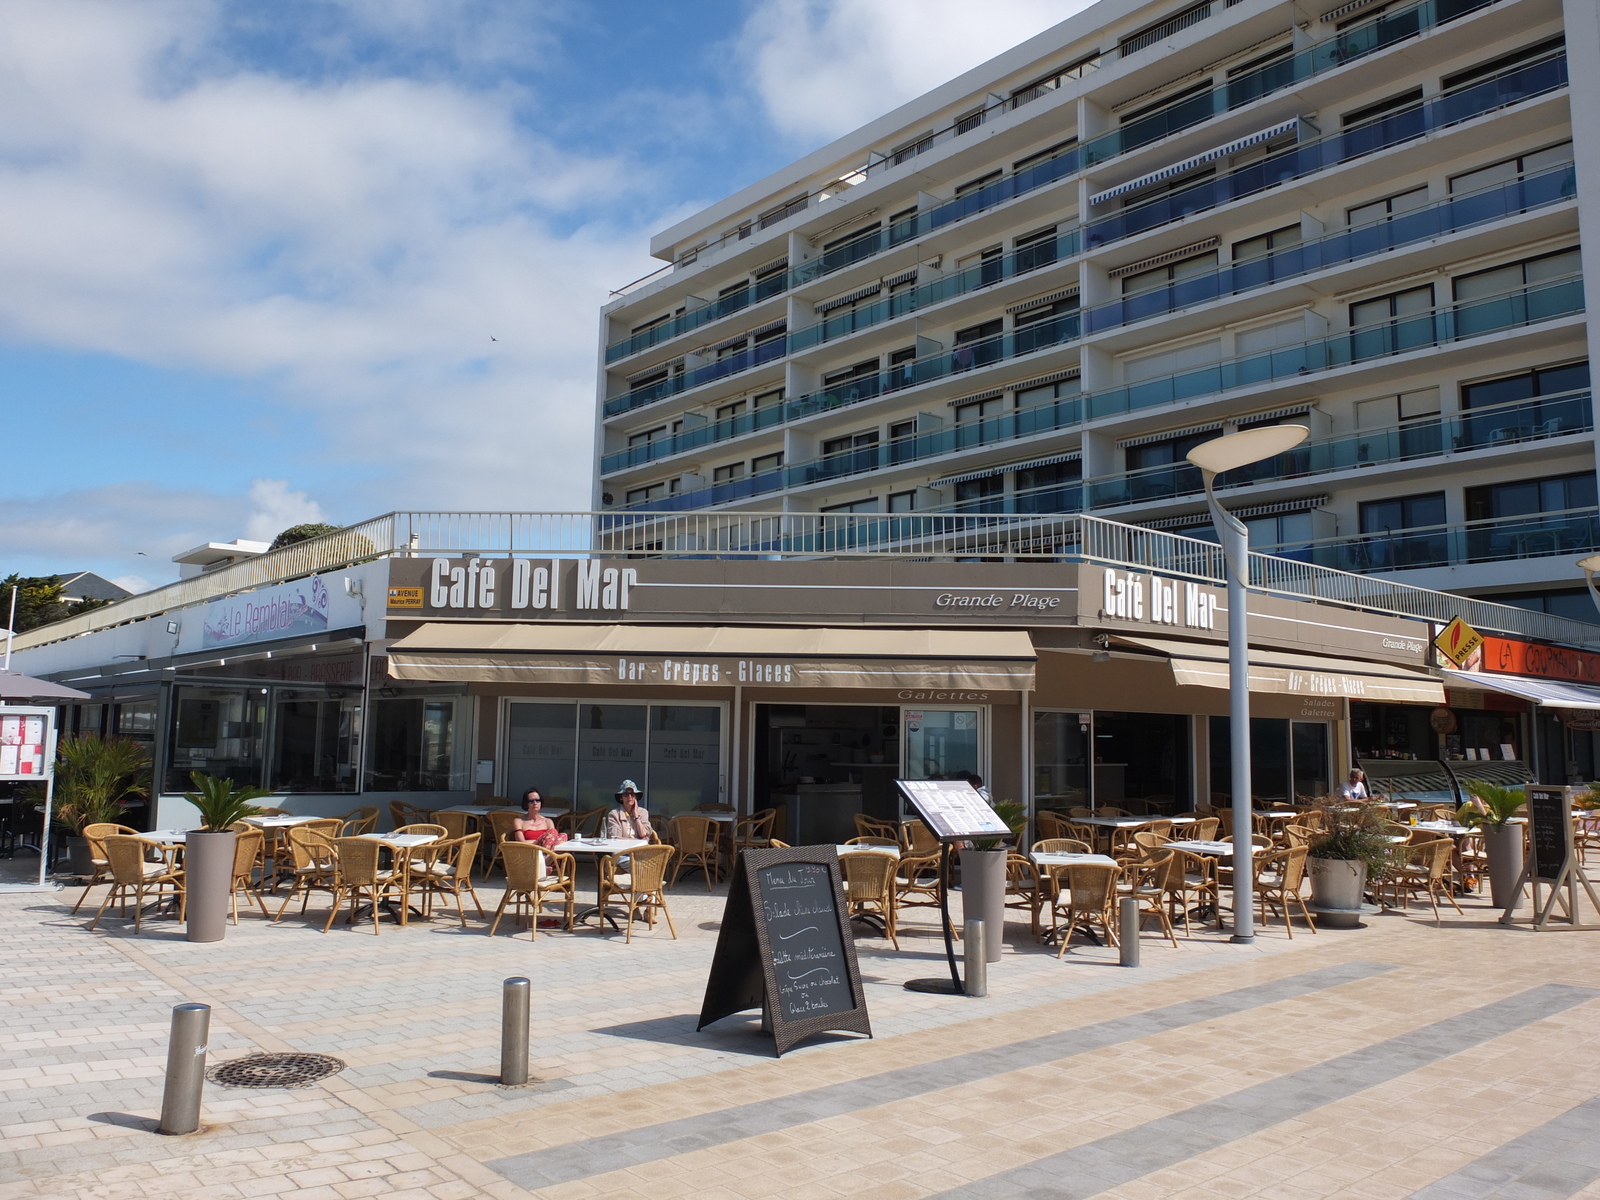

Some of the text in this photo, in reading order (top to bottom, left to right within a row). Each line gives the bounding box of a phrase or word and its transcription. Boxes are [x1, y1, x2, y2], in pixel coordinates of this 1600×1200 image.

[396, 589, 419, 597] AVENUE
[430, 557, 637, 610] Café Del Mar
[935, 592, 1061, 610] Grande Plage
[1103, 568, 1217, 630] Café Del Mar
[229, 594, 292, 637] Le Remblai
[1382, 637, 1423, 654] Grande Plage
[1455, 635, 1479, 661] PRESSE
[1499, 641, 1515, 671] LA
[310, 660, 354, 682] BRASSERIE
[618, 658, 646, 680] Bar
[663, 659, 719, 685] Crêpes
[738, 660, 792, 683] Glaces
[1288, 671, 1303, 691] Bar
[1310, 673, 1337, 695] Crêpes
[1341, 675, 1365, 695] Glaces
[896, 690, 989, 701] Galettes
[1303, 698, 1335, 708] Salades
[1300, 708, 1335, 717] Galettes
[766, 871, 785, 885] Menu
[787, 870, 797, 884] du
